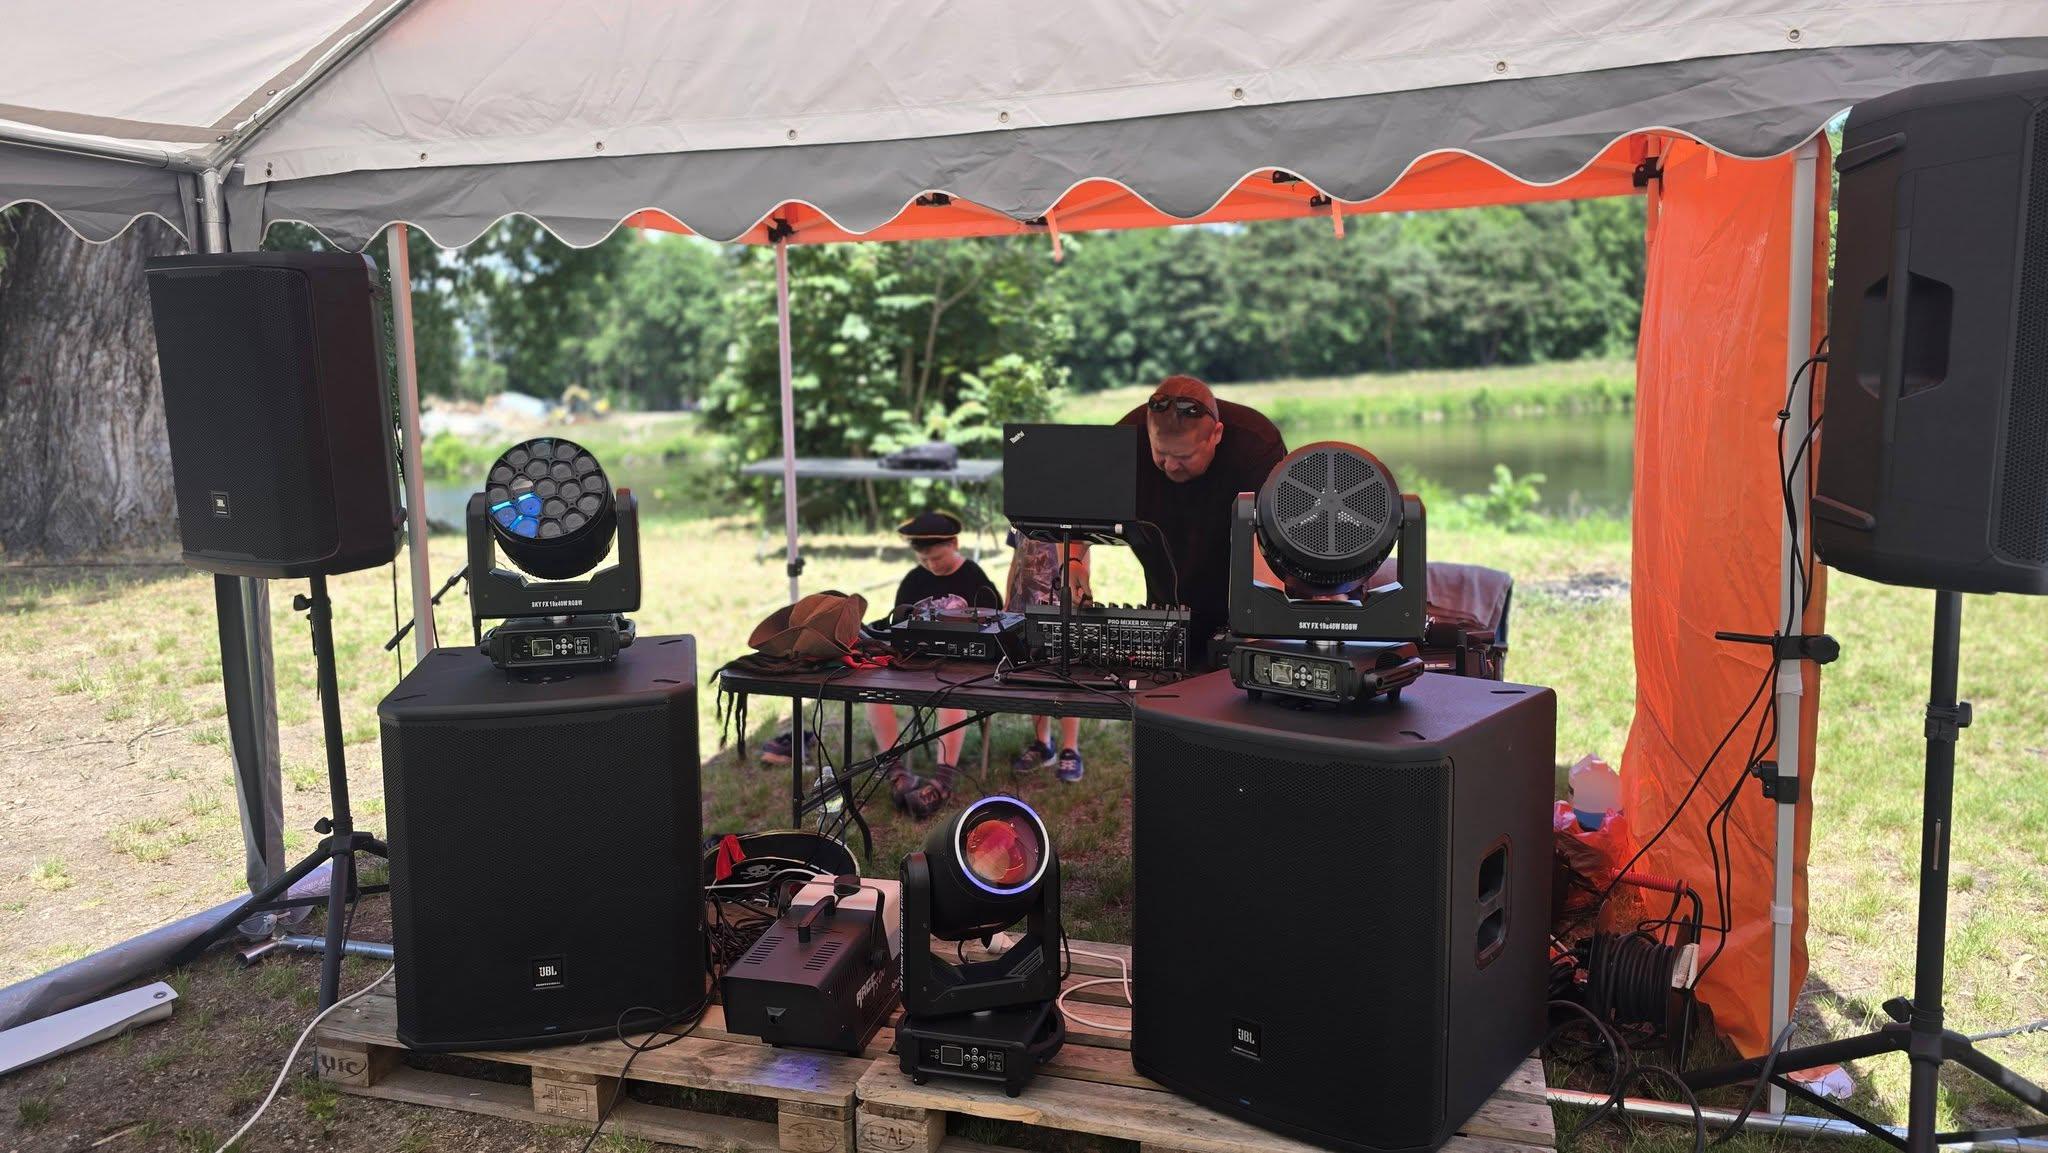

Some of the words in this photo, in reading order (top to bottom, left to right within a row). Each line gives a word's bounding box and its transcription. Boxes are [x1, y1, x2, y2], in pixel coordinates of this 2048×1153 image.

[1298, 621, 1310, 629] SKY
[538, 965, 557, 977] JBL
[1238, 1028, 1255, 1045] JBL
